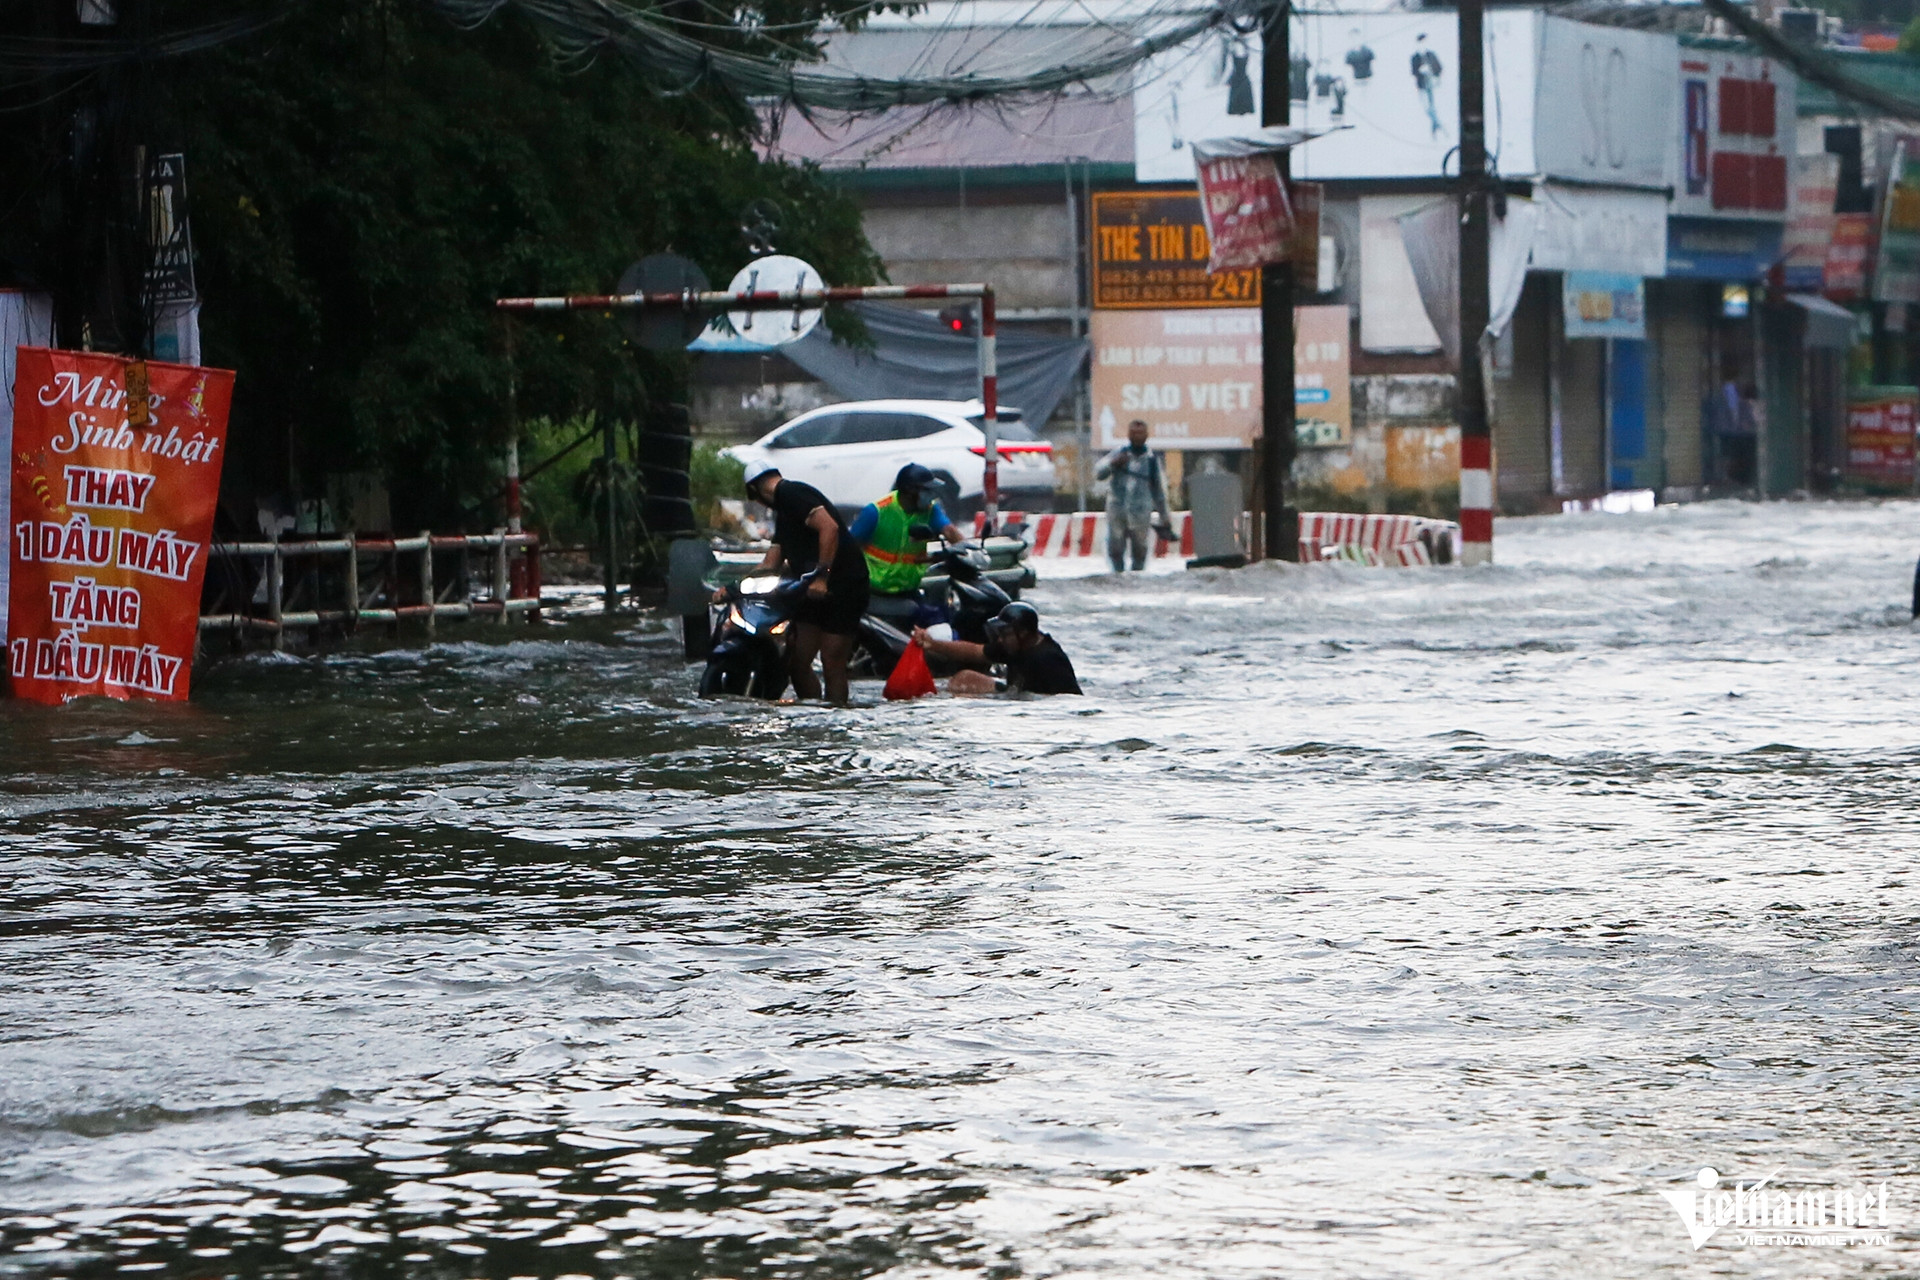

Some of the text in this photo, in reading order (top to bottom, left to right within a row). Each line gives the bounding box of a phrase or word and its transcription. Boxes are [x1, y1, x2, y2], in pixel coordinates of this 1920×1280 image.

[1211, 271, 1254, 299] 247
[38, 371, 166, 426] Mừg
[1122, 383, 1181, 412] SAO
[1188, 377, 1255, 415] VIỆT
[51, 411, 219, 465] Sinh nhật
[65, 465, 155, 513] THAY
[17, 513, 200, 581] 1 DẦU MÁY
[50, 576, 141, 631] TẶNG
[11, 629, 183, 695] 1 DẦU MÁY
